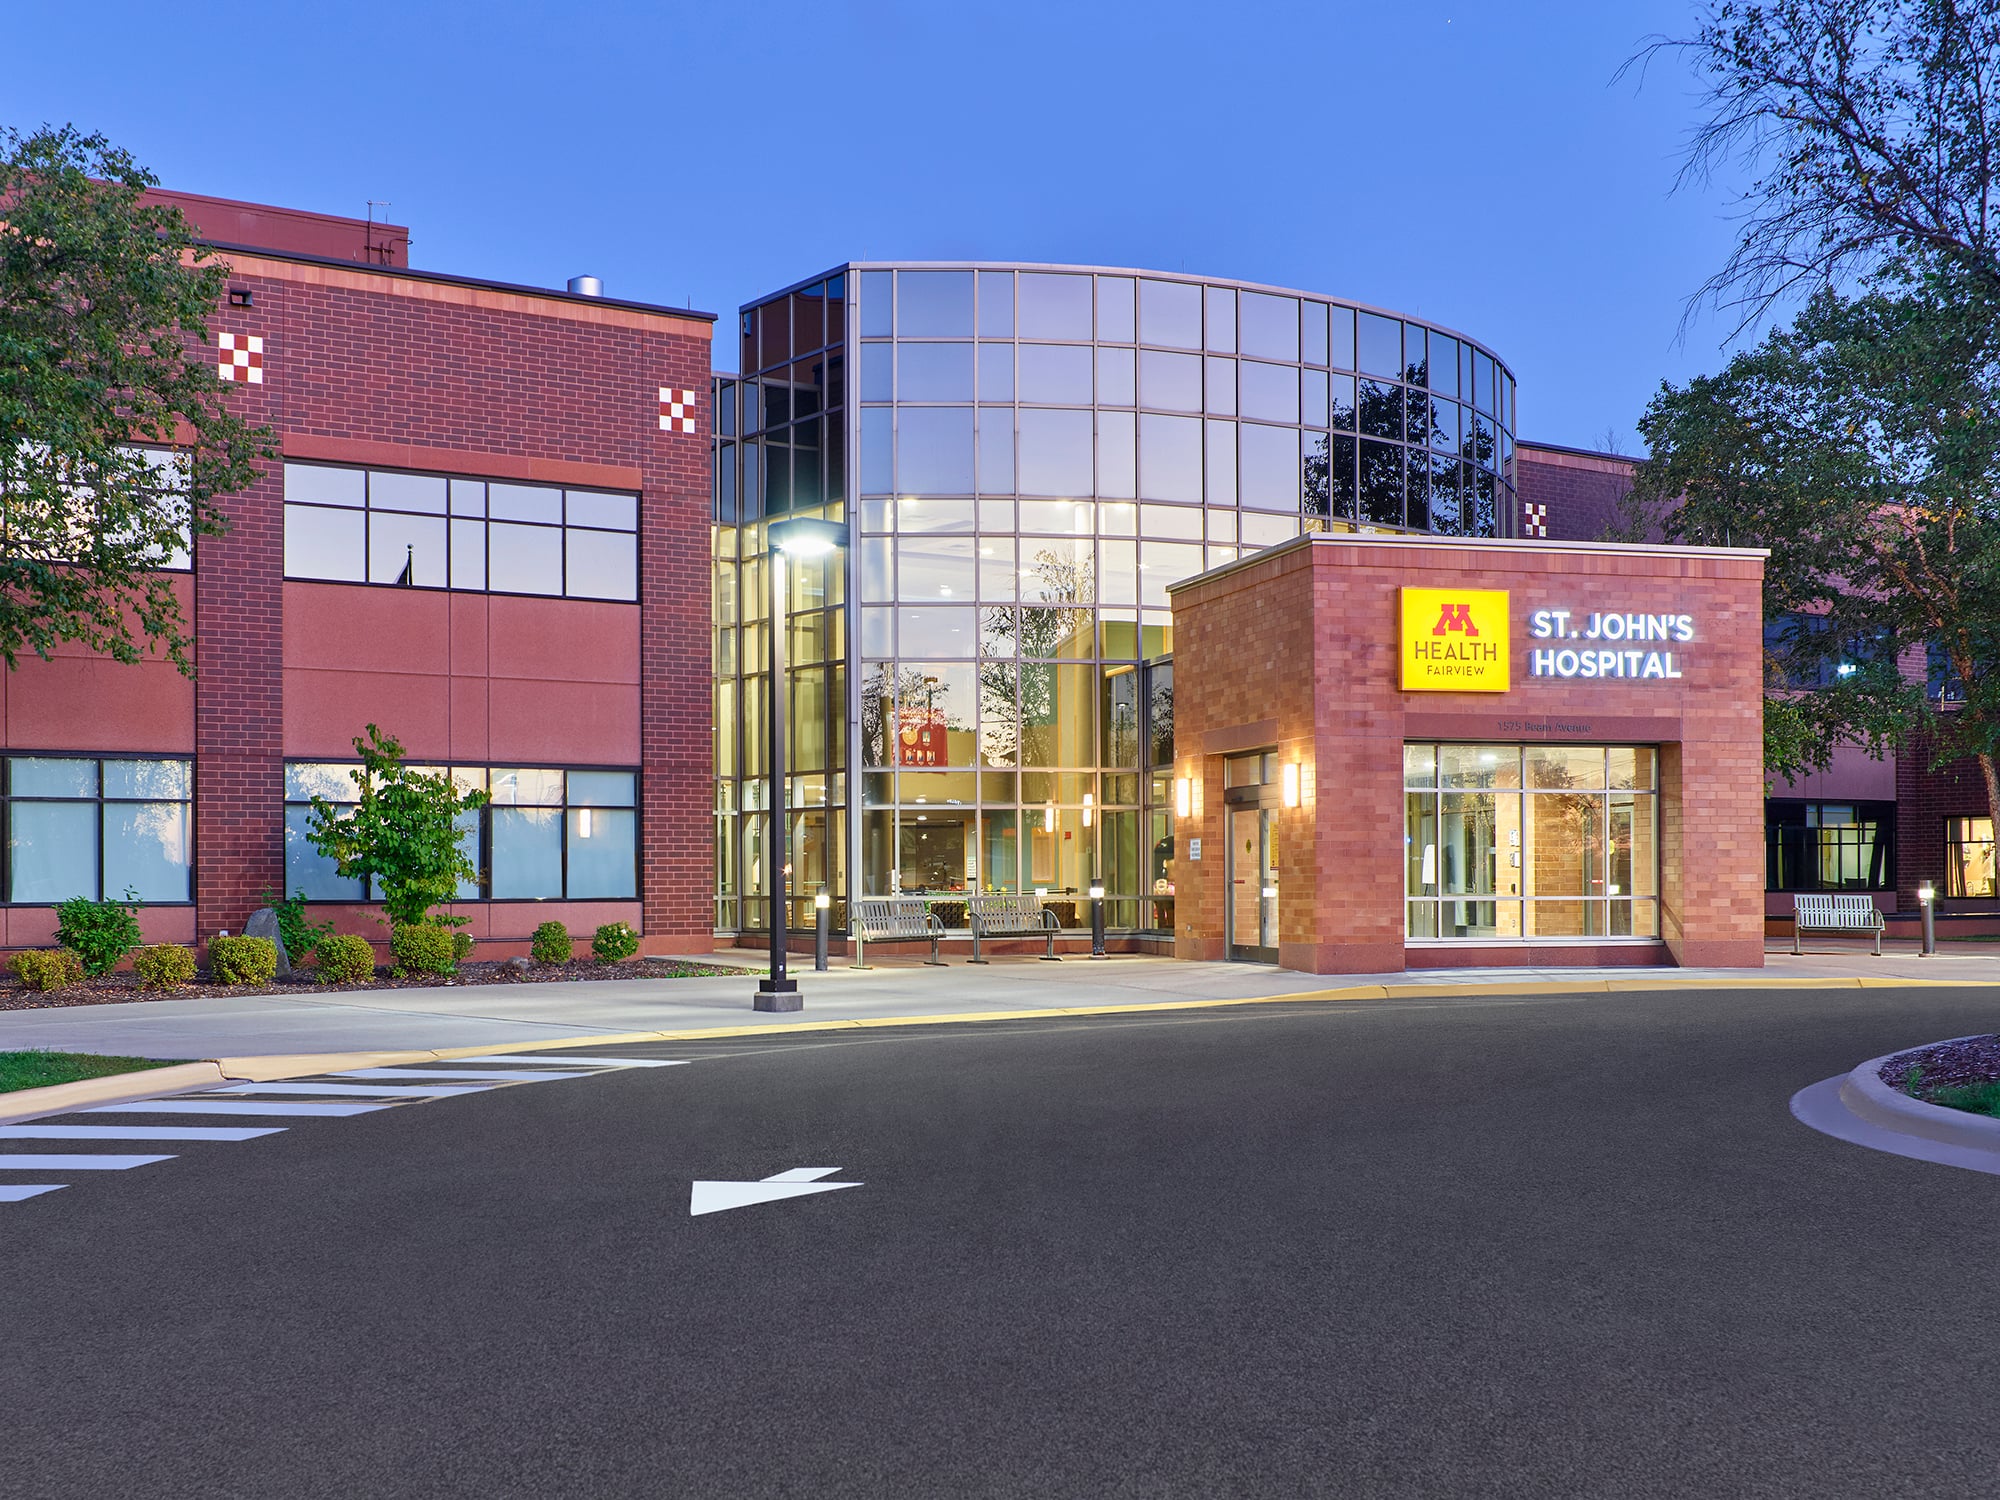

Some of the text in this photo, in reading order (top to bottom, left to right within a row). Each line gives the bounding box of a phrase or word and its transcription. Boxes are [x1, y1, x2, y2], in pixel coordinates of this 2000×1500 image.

[1432, 603, 1479, 637] M
[1533, 610, 1694, 641] ST. JOHN'S
[1415, 641, 1497, 661] HEALTH
[1426, 665, 1485, 676] FAIRVIEW
[1533, 649, 1682, 679] HOSPITAL
[1498, 720, 1593, 733] 1575 Beam Avenue
